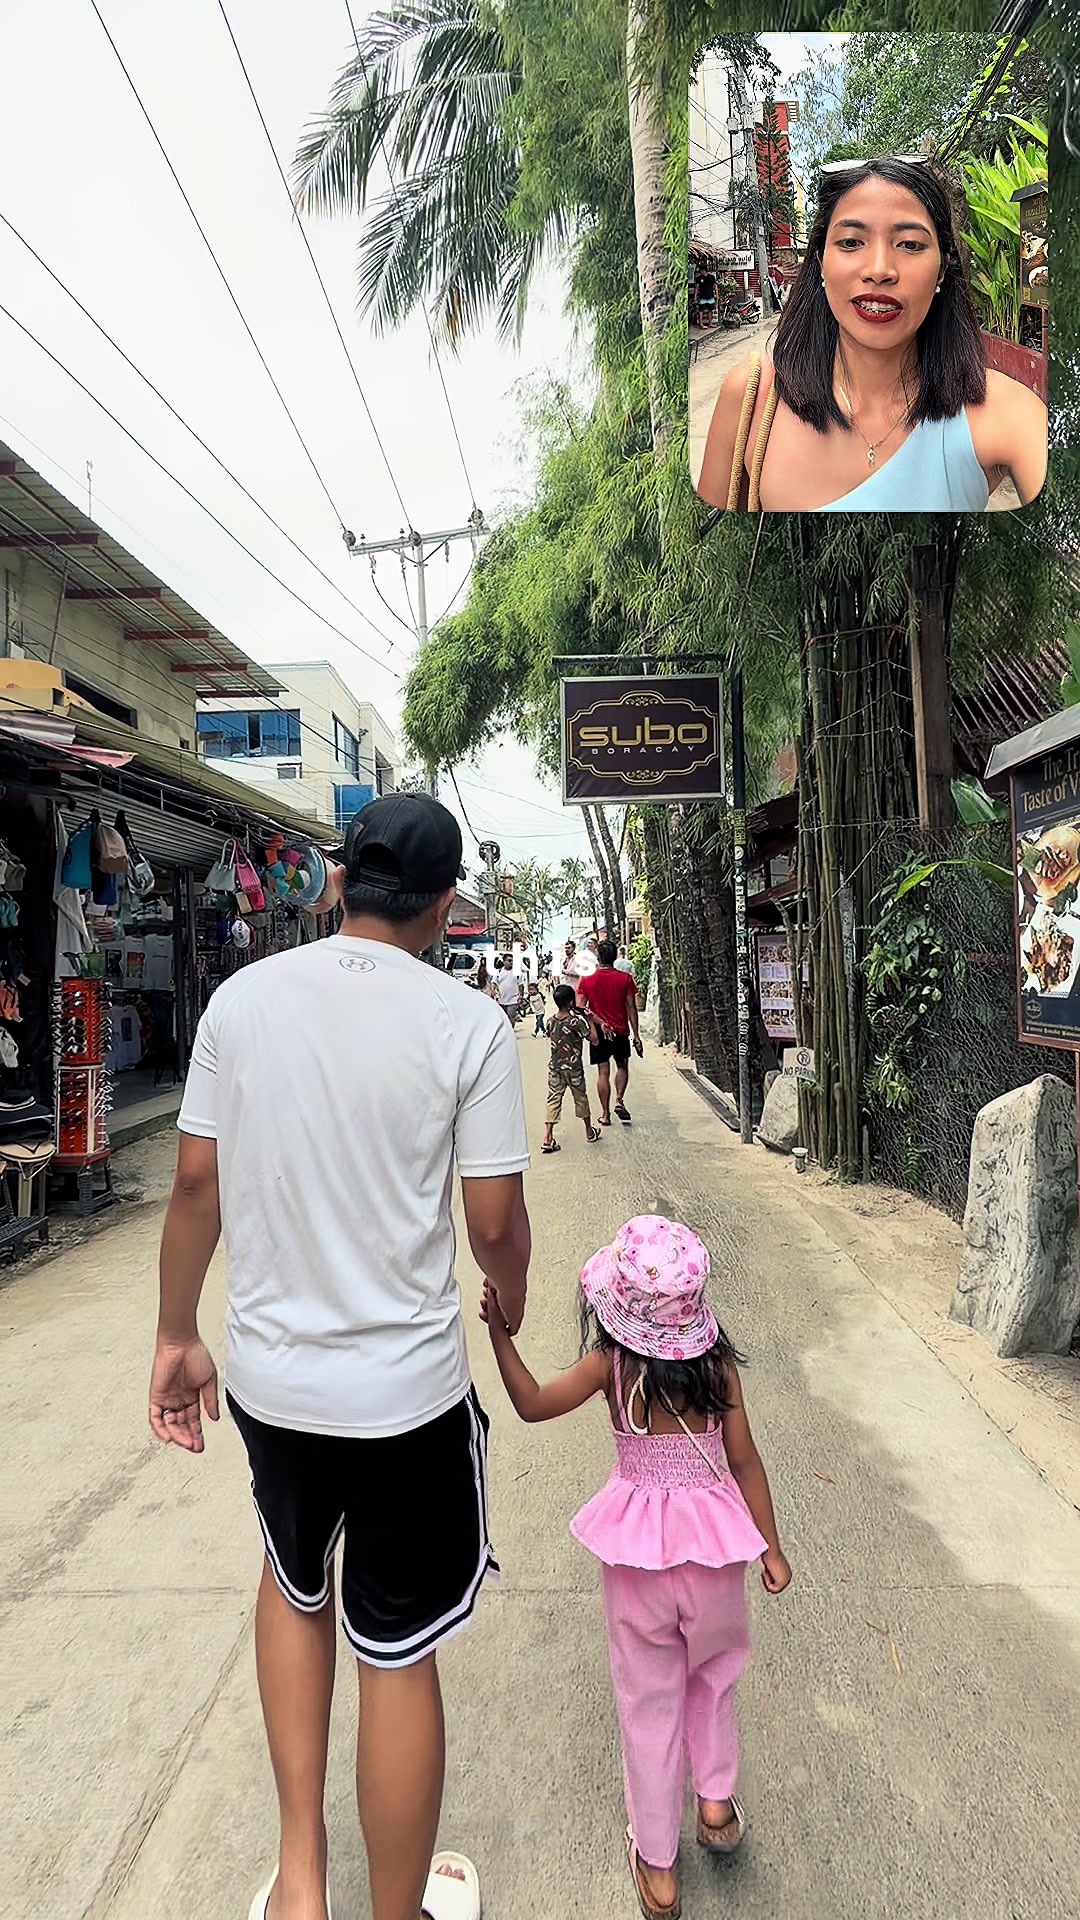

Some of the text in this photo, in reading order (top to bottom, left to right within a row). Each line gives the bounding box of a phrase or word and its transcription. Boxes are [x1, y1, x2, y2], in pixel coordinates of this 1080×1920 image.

[579, 717, 708, 747] subo
[592, 746, 695, 755] BORACAY
[1041, 756, 1063, 781] The
[1021, 788, 1052, 814] Taste
[1053, 773, 1068, 802] of
[784, 1066, 793, 1076] NO
